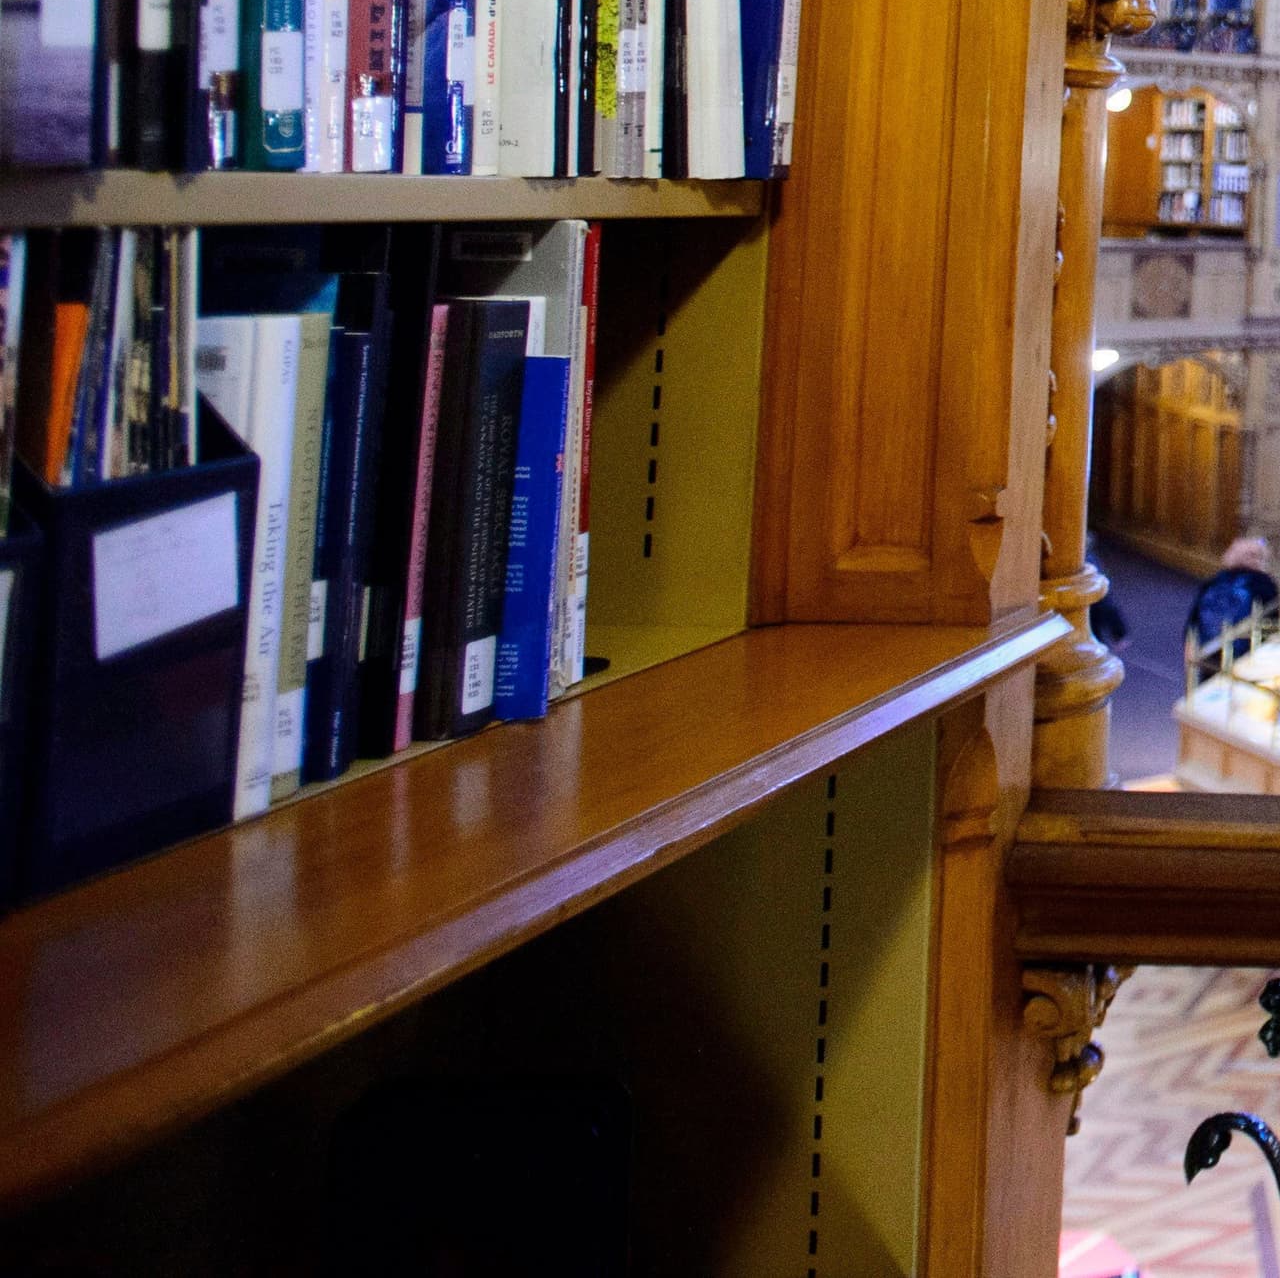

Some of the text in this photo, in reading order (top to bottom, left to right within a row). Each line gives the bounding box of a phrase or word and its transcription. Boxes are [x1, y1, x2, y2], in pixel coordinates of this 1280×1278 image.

[487, 21, 497, 70] CANADA
[486, 72, 496, 85] LE
[477, 416, 489, 469] CANADA
[475, 474, 484, 502] AND
[257, 502, 283, 656] Taking the Air
[470, 529, 480, 582] UNITED
[466, 584, 475, 629] STATES
